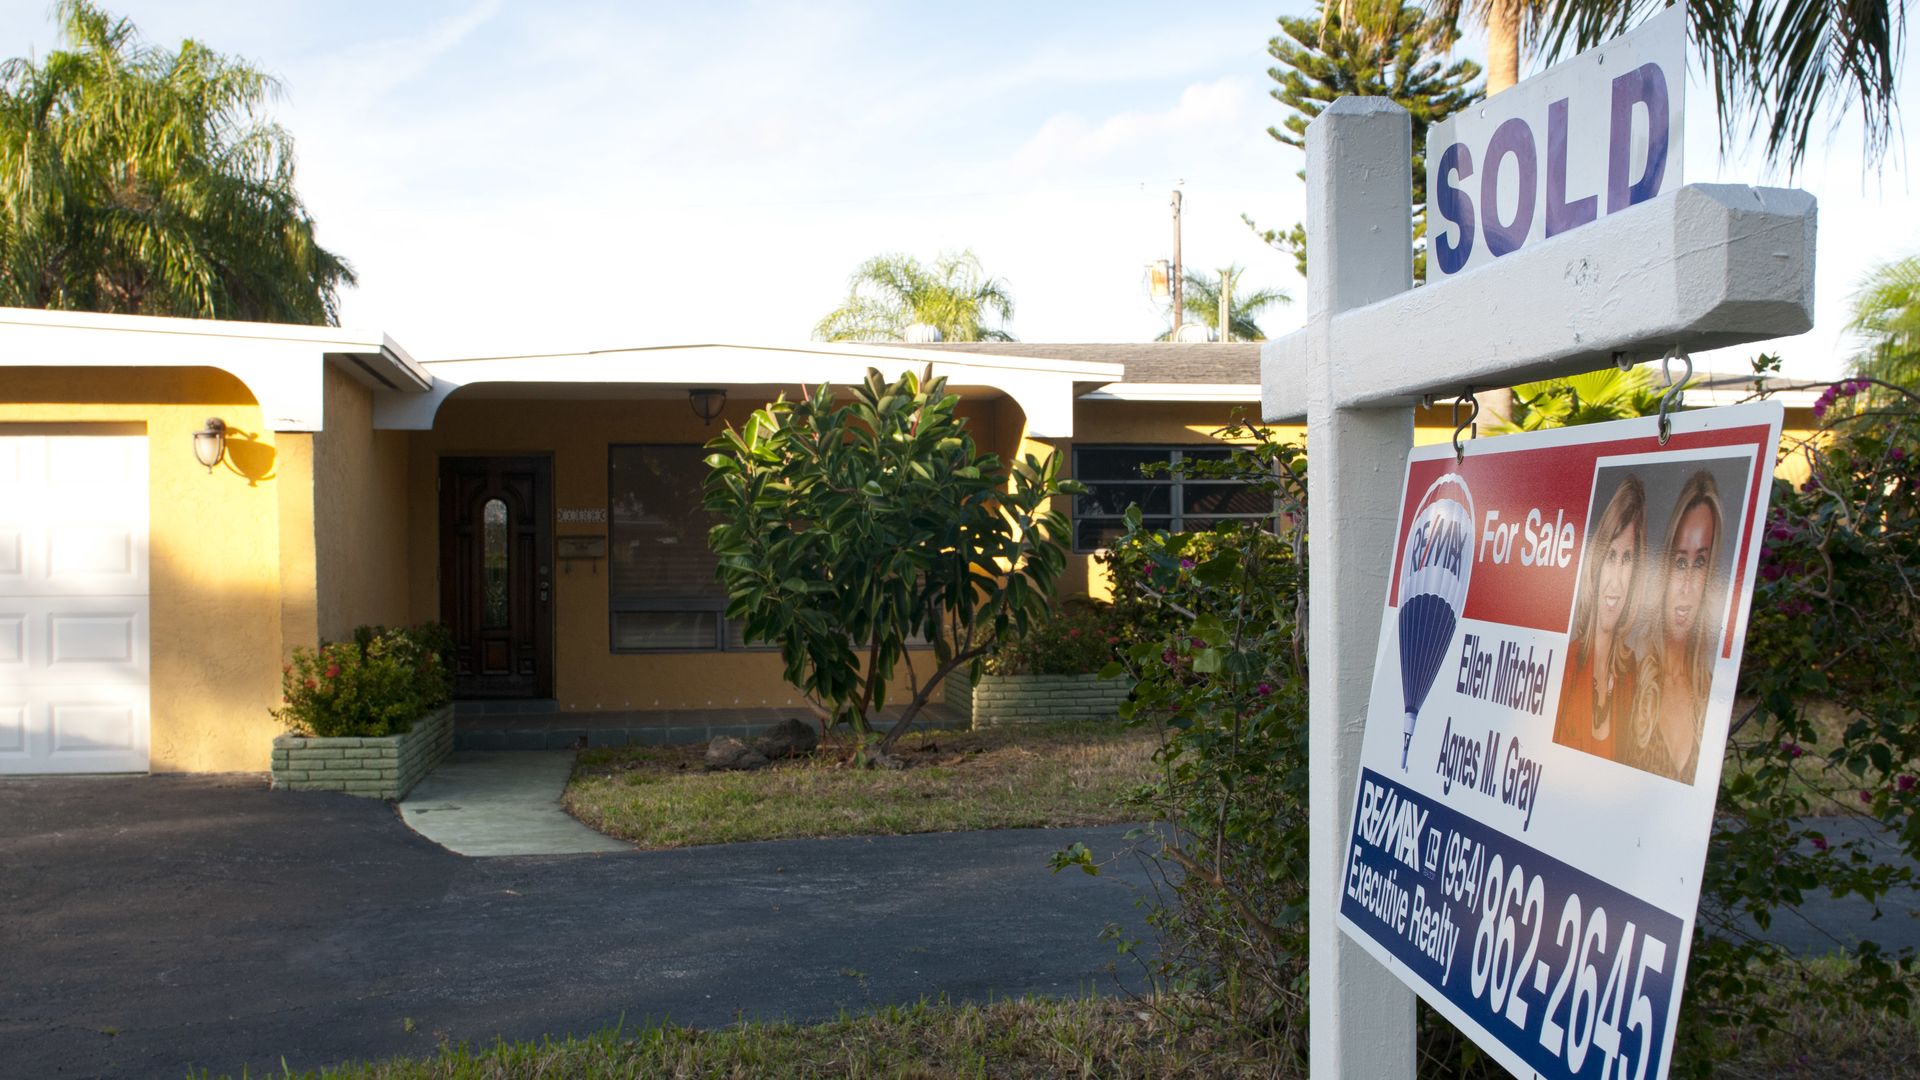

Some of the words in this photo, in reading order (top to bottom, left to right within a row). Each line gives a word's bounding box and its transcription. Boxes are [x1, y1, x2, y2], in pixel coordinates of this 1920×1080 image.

[1435, 62, 1670, 275] SOLD
[1409, 514, 1467, 581] RE/MAX
[1478, 510, 1519, 565] For
[1520, 508, 1575, 568] Sale
[1456, 633, 1493, 700] Ellen
[1492, 640, 1553, 716] Mitchel
[1357, 780, 1429, 872] RE/MAX
[1436, 716, 1481, 796] Agnes
[1480, 730, 1501, 798] M.
[1502, 736, 1543, 832] Gray
[1347, 844, 1410, 936] Executive
[1408, 884, 1460, 987] Realty
[1441, 829, 1485, 914] (954)
[1471, 854, 1667, 1080] 862-2645
